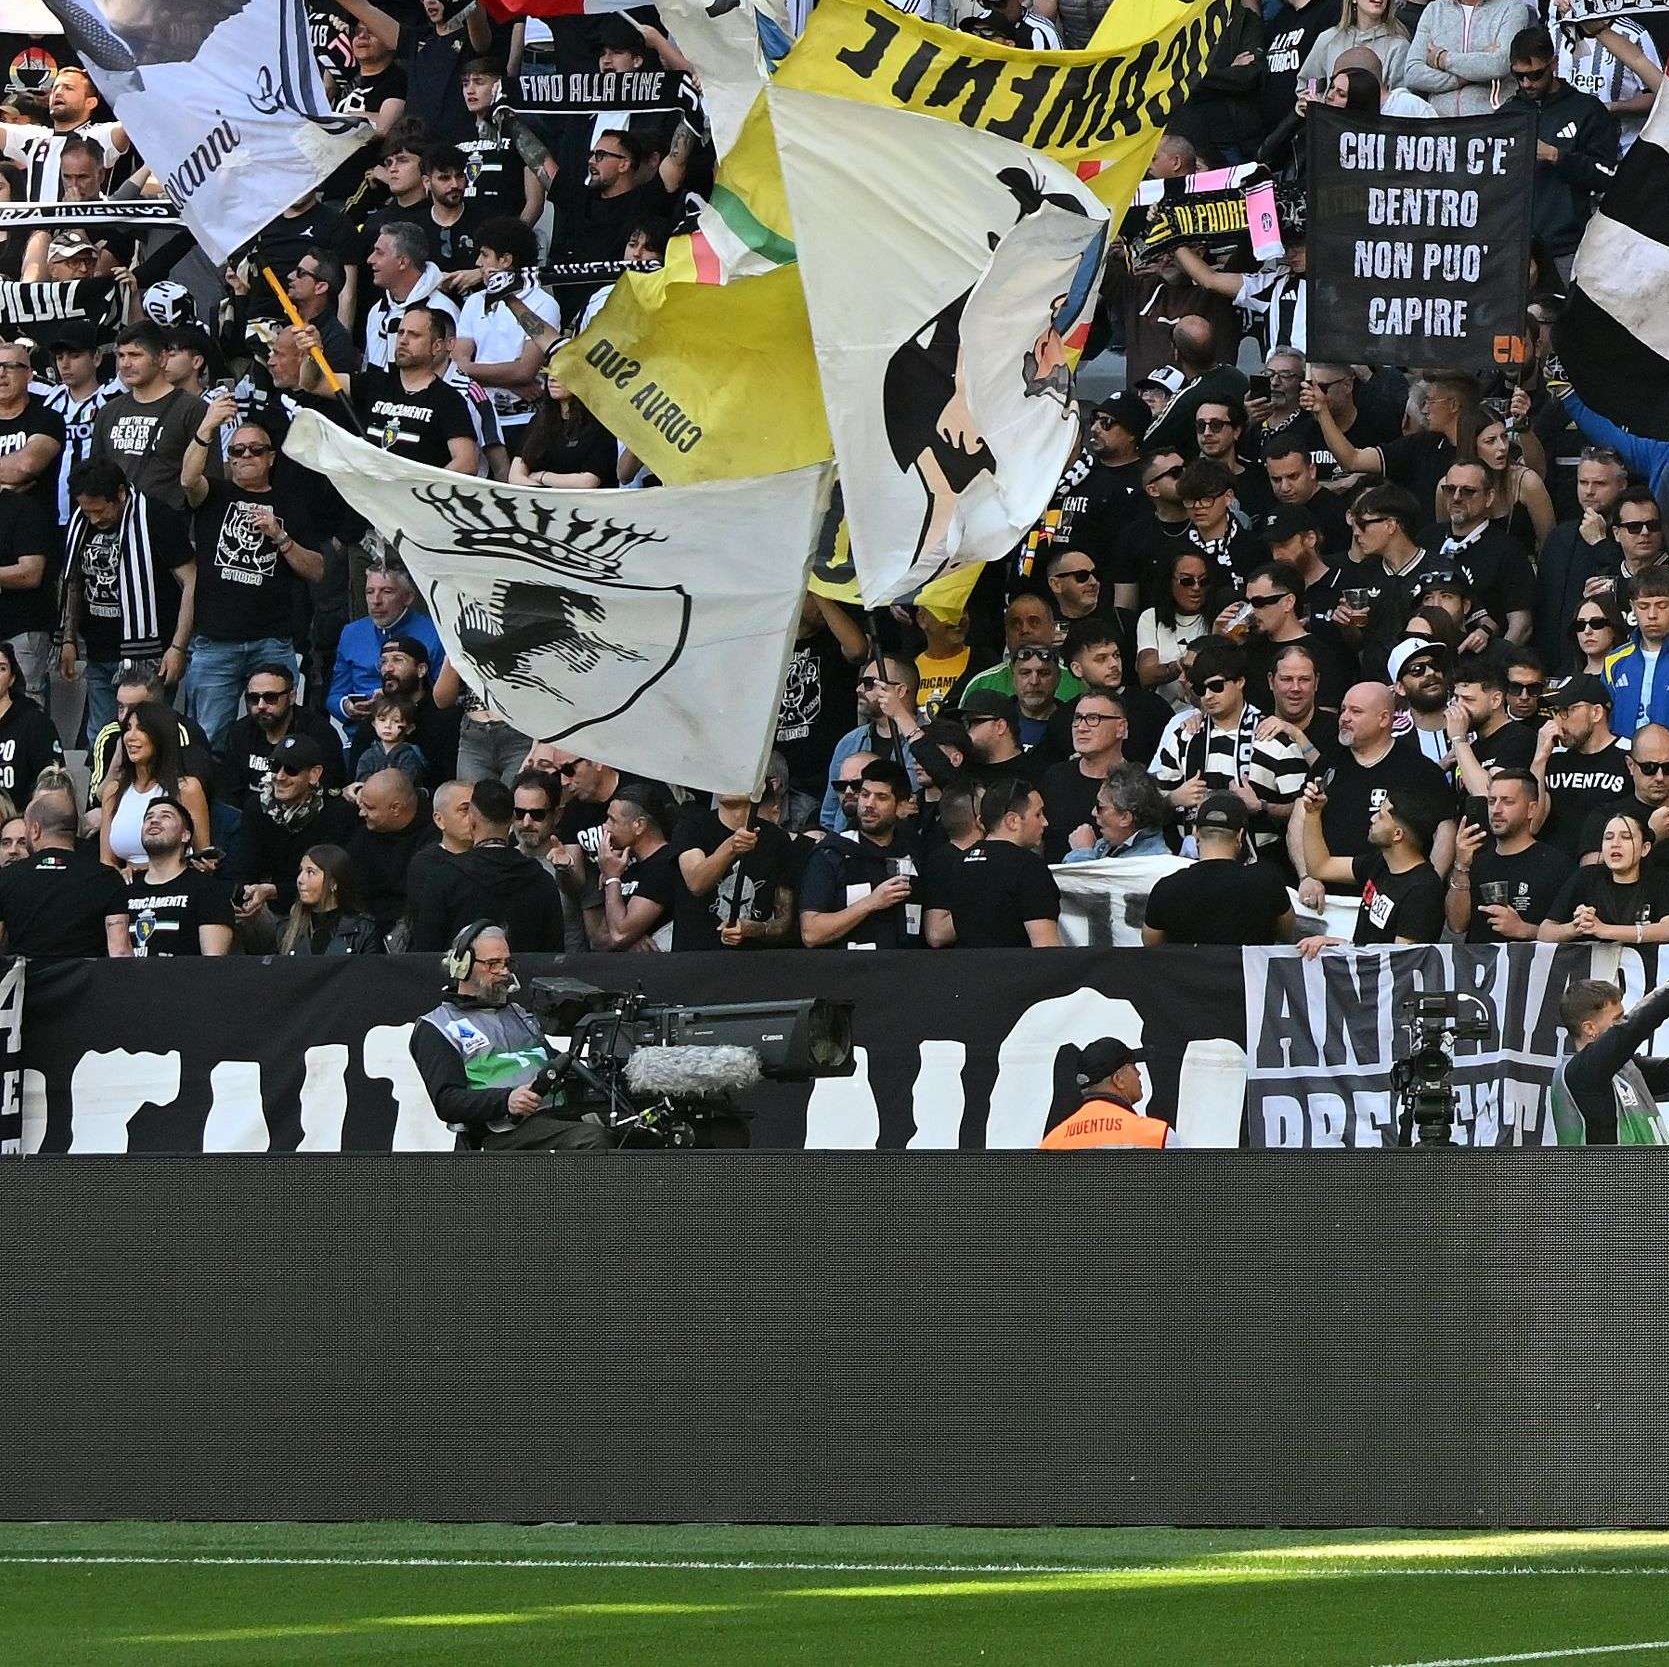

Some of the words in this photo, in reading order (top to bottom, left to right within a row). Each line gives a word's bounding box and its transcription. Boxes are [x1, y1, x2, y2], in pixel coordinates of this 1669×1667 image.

[522, 75, 562, 101] FINO
[569, 75, 616, 102] ALLA
[622, 71, 664, 101] FINE
[1569, 73, 1605, 92] Jeep
[1340, 132, 1387, 171] CHI
[1395, 135, 1456, 173] NON
[1467, 136, 1514, 174] C'E'
[1196, 202, 1247, 233] PADRE
[1368, 188, 1480, 229] DENTRO
[1354, 242, 1416, 281] NON
[1421, 246, 1490, 283] PUO'
[1368, 296, 1469, 338] CAPIRE
[761, 1033, 784, 1043] Canon
[1065, 1118, 1122, 1134] JUVENTUS
